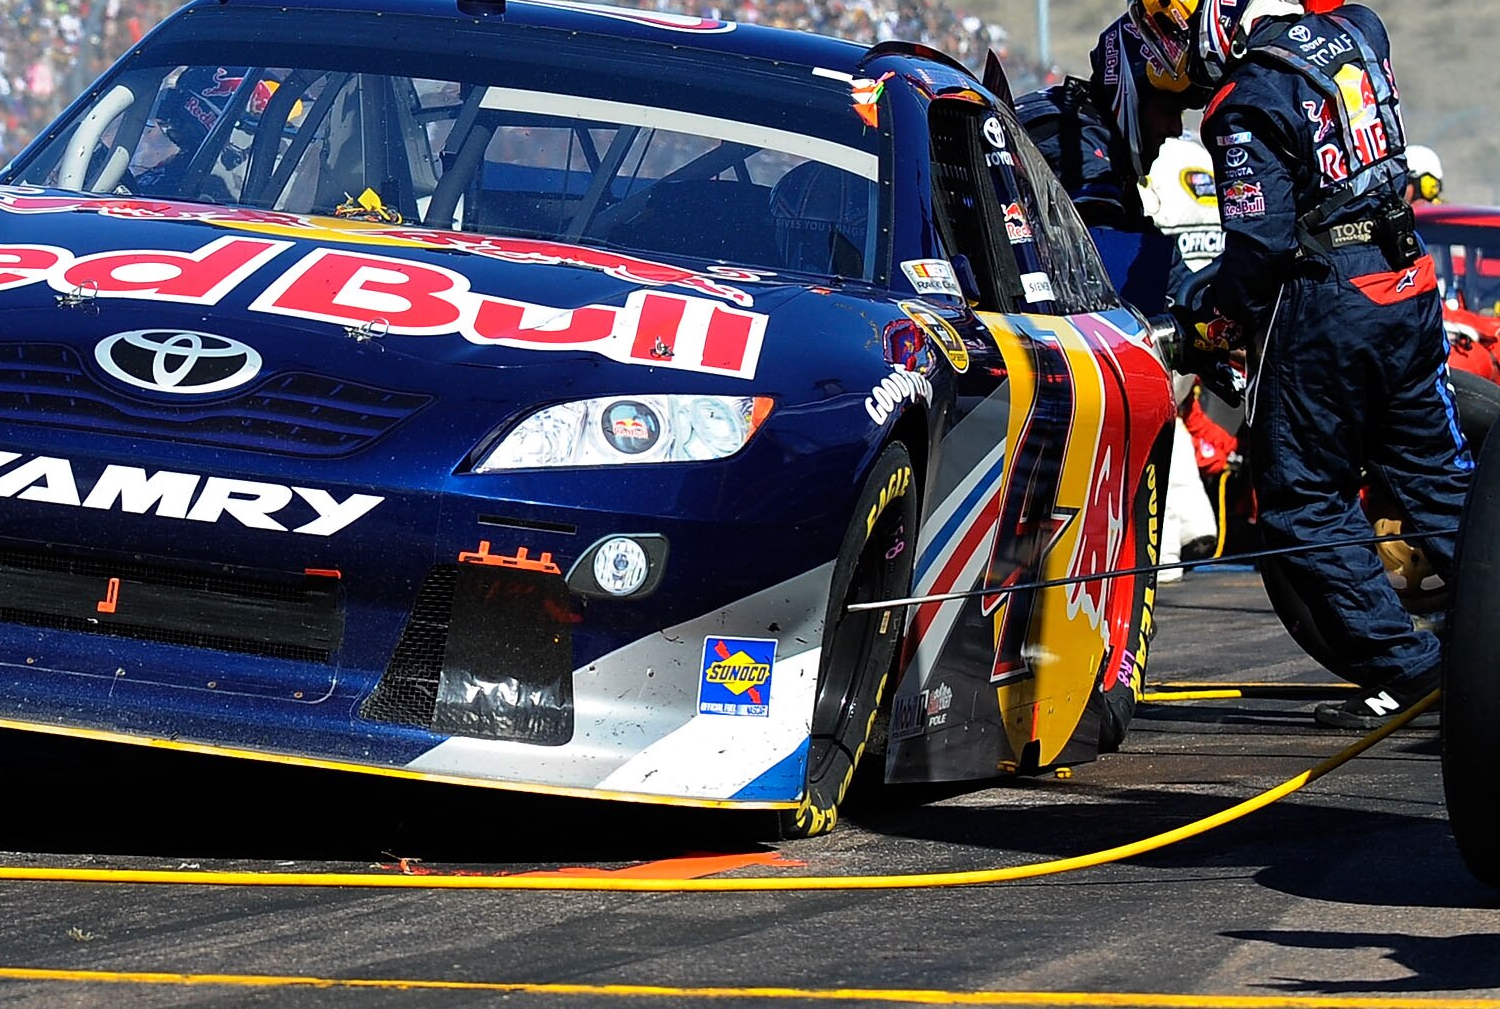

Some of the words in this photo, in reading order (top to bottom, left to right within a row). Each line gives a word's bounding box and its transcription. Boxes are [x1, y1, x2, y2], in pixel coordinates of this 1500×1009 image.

[1225, 166, 1254, 178] TOYOTA
[248, 248, 769, 380] Bull
[866, 466, 911, 541] EAGLE
[708, 663, 768, 682] SUNOCO
[1364, 690, 1400, 717] N
[929, 713, 947, 727] POLE
